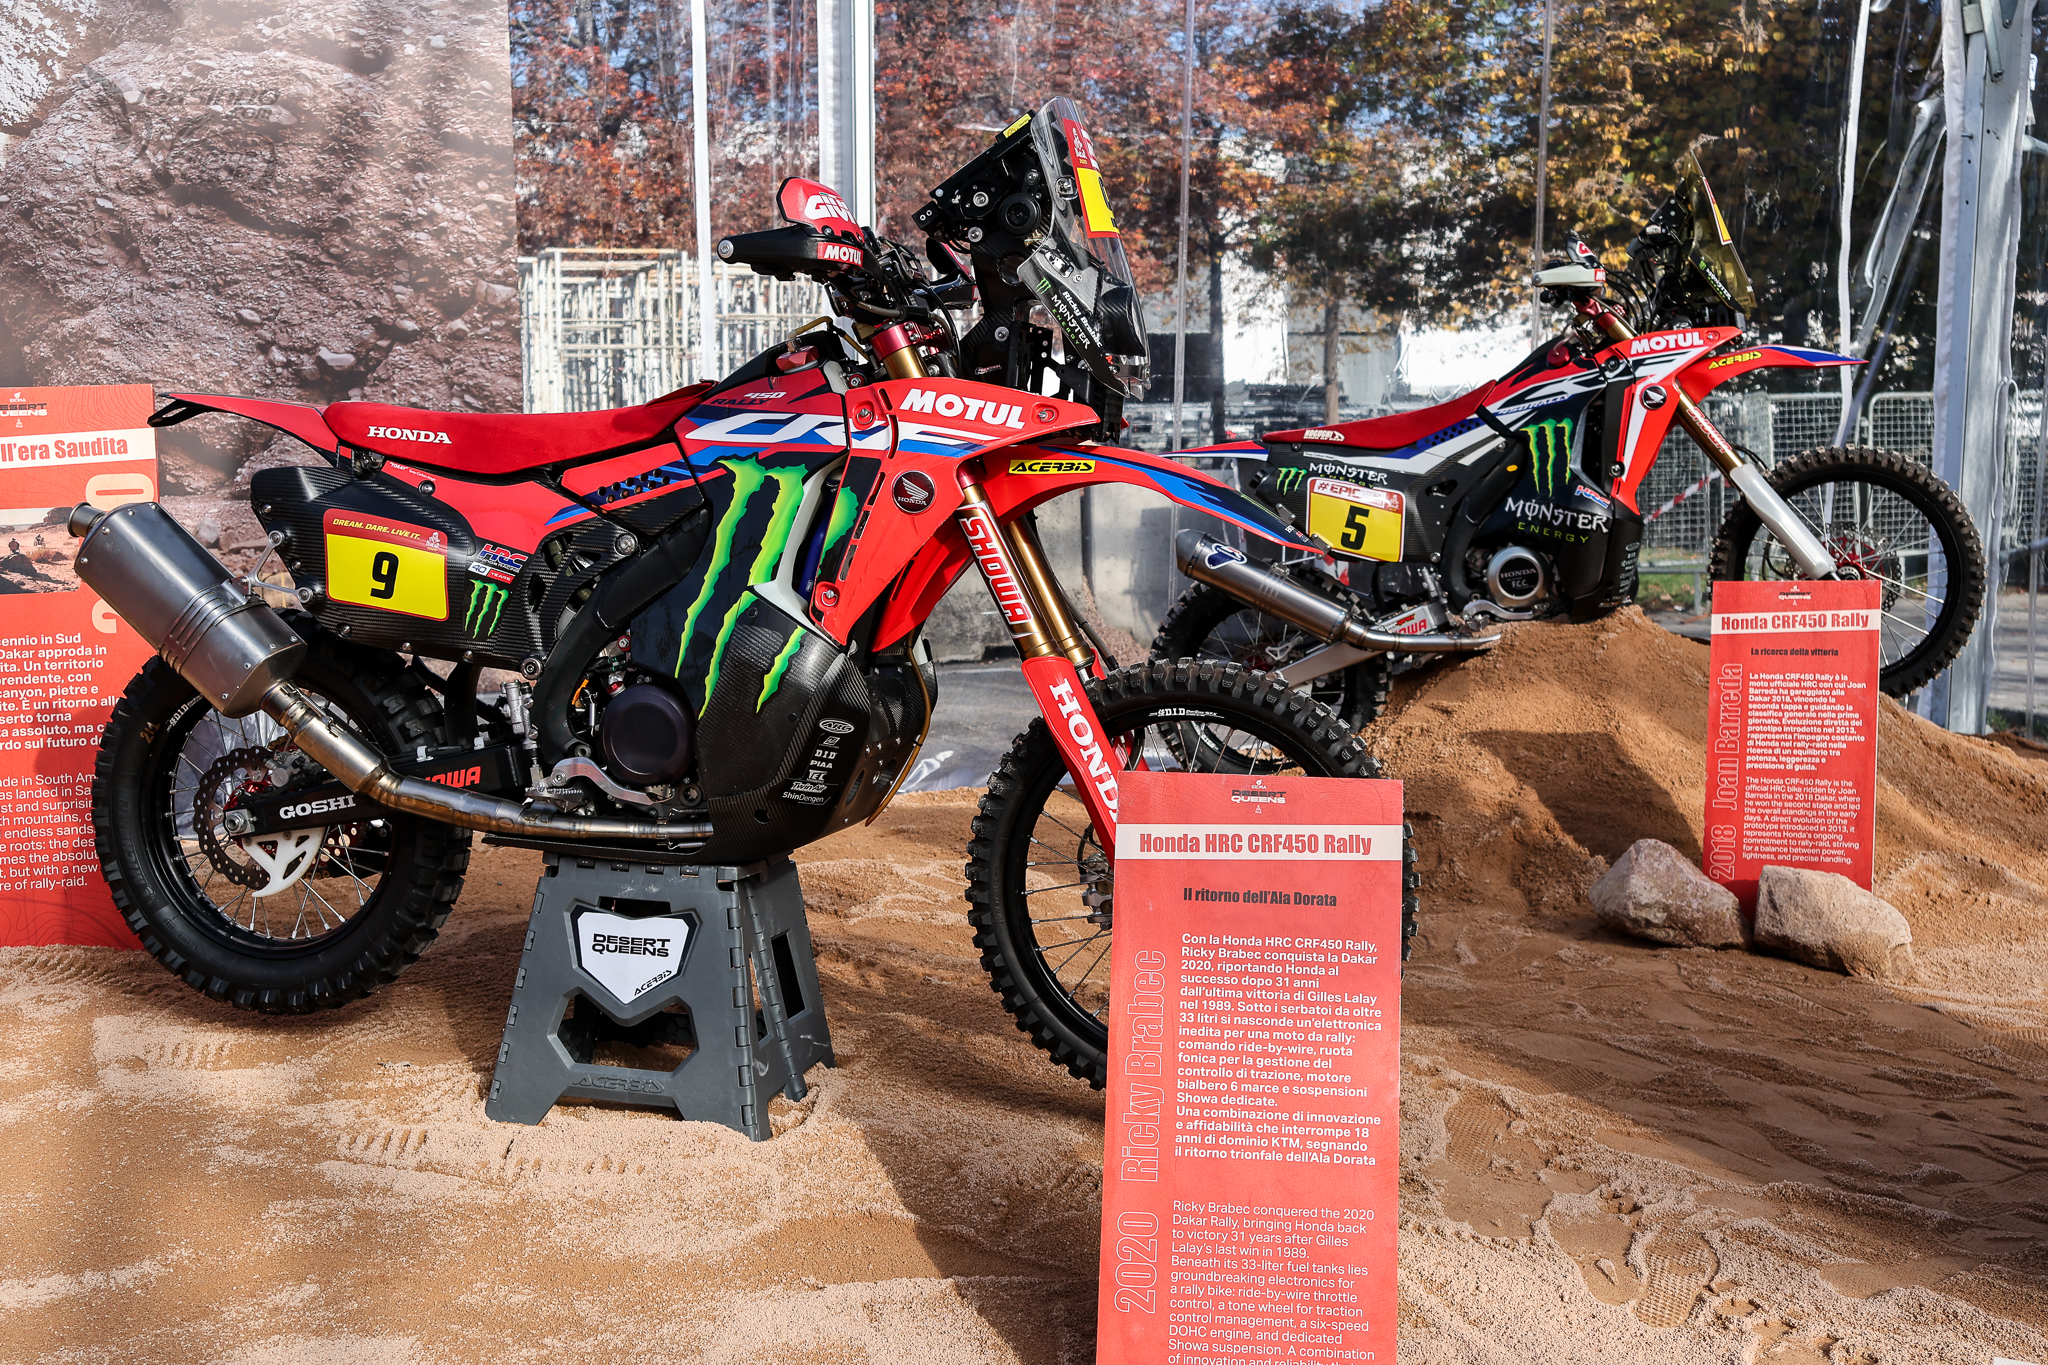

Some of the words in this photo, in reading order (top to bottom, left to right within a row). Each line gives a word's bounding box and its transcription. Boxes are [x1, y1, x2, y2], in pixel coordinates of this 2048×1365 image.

[824, 244, 862, 265] MOTUL
[1051, 294, 1091, 349] MONSTER
[1052, 309, 1080, 345] ENERGY
[1062, 290, 1082, 317] Ricky
[1080, 315, 1103, 348] Brabec
[1630, 331, 1704, 355] MOTUL
[1708, 351, 1763, 370] ACERBIS
[709, 398, 767, 406] RALLY
[744, 391, 787, 399] 450
[899, 388, 1026, 430] MOTUL
[366, 425, 453, 444] HONDA
[54, 437, 128, 459] Saudita
[1012, 462, 1093, 472] ACERBIS
[1309, 462, 1388, 486] MONSTER
[897, 496, 928, 506] HONDA
[1574, 485, 1611, 509] HRC
[1504, 497, 1610, 534] MONSTER
[332, 518, 364, 529] DREAM.
[365, 522, 390, 534] DARE.
[391, 528, 410, 537] LIVE
[408, 531, 420, 540] IT.
[1340, 505, 1371, 551] 5
[1517, 521, 1590, 544] ENERGY
[478, 543, 528, 569] HRC
[370, 551, 399, 600] 9
[471, 564, 488, 574] 40
[491, 572, 511, 582] YEARS
[959, 517, 1034, 625] SHOWA
[1500, 567, 1537, 579] HONDA
[1721, 615, 1768, 631] Honda
[1771, 613, 1827, 629] CRF450
[1831, 612, 1869, 628] Rally
[37, 645, 92, 658] approda
[94, 644, 107, 655] in
[1751, 647, 1760, 655] La
[1760, 647, 1789, 656] ricerca
[1790, 647, 1809, 656] della
[1810, 648, 1839, 656] vittoria
[23, 660, 41, 671] Un
[43, 657, 103, 670] territorio
[1715, 663, 1743, 753] Barreda
[814, 749, 838, 760] D.I.D
[1049, 677, 1119, 823] HOND
[809, 759, 833, 769] PIAA
[1712, 757, 1739, 810] Joan
[1745, 776, 1759, 784] The
[1760, 776, 1783, 784] Honda
[1784, 777, 1813, 785] CRF450
[1814, 778, 1832, 787] Rally
[1840, 779, 1853, 787] the
[15, 786, 58, 799] landed
[61, 786, 72, 796] in
[782, 791, 824, 804] ShinDengen
[1231, 795, 1286, 804] QUEENS
[1232, 789, 1286, 797] DESERT
[279, 794, 357, 820] GOSHI
[9, 840, 45, 851] roots:
[48, 839, 69, 849] the
[1139, 833, 1200, 853] Honda
[1205, 833, 1243, 853] HRC
[1247, 833, 1319, 853] CRF450
[1323, 834, 1372, 855] Rally
[1710, 824, 1737, 880] 2018
[9, 866, 30, 877] but
[32, 864, 58, 875] with
[61, 865, 69, 874] a
[72, 864, 97, 873] new
[14, 878, 27, 890] of
[30, 875, 87, 889] rally-raid.
[1183, 887, 1193, 901] Il
[1194, 887, 1240, 903] ritorno
[1242, 889, 1291, 905] dell'Ala
[1293, 891, 1337, 907] Dorata
[592, 933, 671, 948] DESERT
[1181, 933, 1206, 944] Con
[1209, 934, 1219, 944] la
[1222, 934, 1262, 946] Honda
[1265, 936, 1292, 947] HRC
[1294, 937, 1342, 949] CRF450
[1345, 939, 1377, 951] Rally,
[591, 943, 670, 958] QUEENS
[1181, 946, 1215, 958] Ricky
[1218, 947, 1261, 959] Brabec
[1263, 951, 1324, 962] conquista
[1327, 952, 1338, 962] la
[1341, 952, 1378, 964] Dakar
[1180, 959, 1214, 971] 2020,
[1217, 960, 1282, 973] riportando
[1285, 963, 1325, 975] Honda
[1327, 965, 1338, 976] al
[633, 969, 673, 997] ACERBIS
[1180, 974, 1238, 984] successo
[1240, 975, 1272, 986] dopo
[1275, 976, 1289, 986] 31
[1292, 977, 1319, 988] anni
[1179, 985, 1243, 998] dall'ultima
[1245, 988, 1290, 1000] vittoria
[1292, 990, 1304, 1000] di
[1307, 990, 1341, 1002] Gilles
[1344, 992, 1377, 1004] Lalay
[1125, 950, 1166, 1077] Brabec
[1121, 1082, 1165, 1182] Ricky
[1173, 1200, 1205, 1213] Ricky
[1208, 1201, 1250, 1214] Brabec
[1253, 1206, 1317, 1217] conquered
[1320, 1207, 1340, 1218] the
[1343, 1208, 1374, 1220] 2020
[1172, 1213, 1207, 1226] Dakar
[1210, 1215, 1239, 1230] Rally,
[1243, 1217, 1291, 1232] bringing
[1295, 1219, 1334, 1232] Honda
[1337, 1221, 1366, 1234] back
[1171, 1228, 1184, 1238] to
[1186, 1228, 1228, 1241] victory
[1230, 1230, 1244, 1241] 31
[1248, 1233, 1281, 1243] years
[1284, 1233, 1313, 1245] after
[1315, 1234, 1348, 1247] Gilles
[1114, 1211, 1159, 1314] 2020
